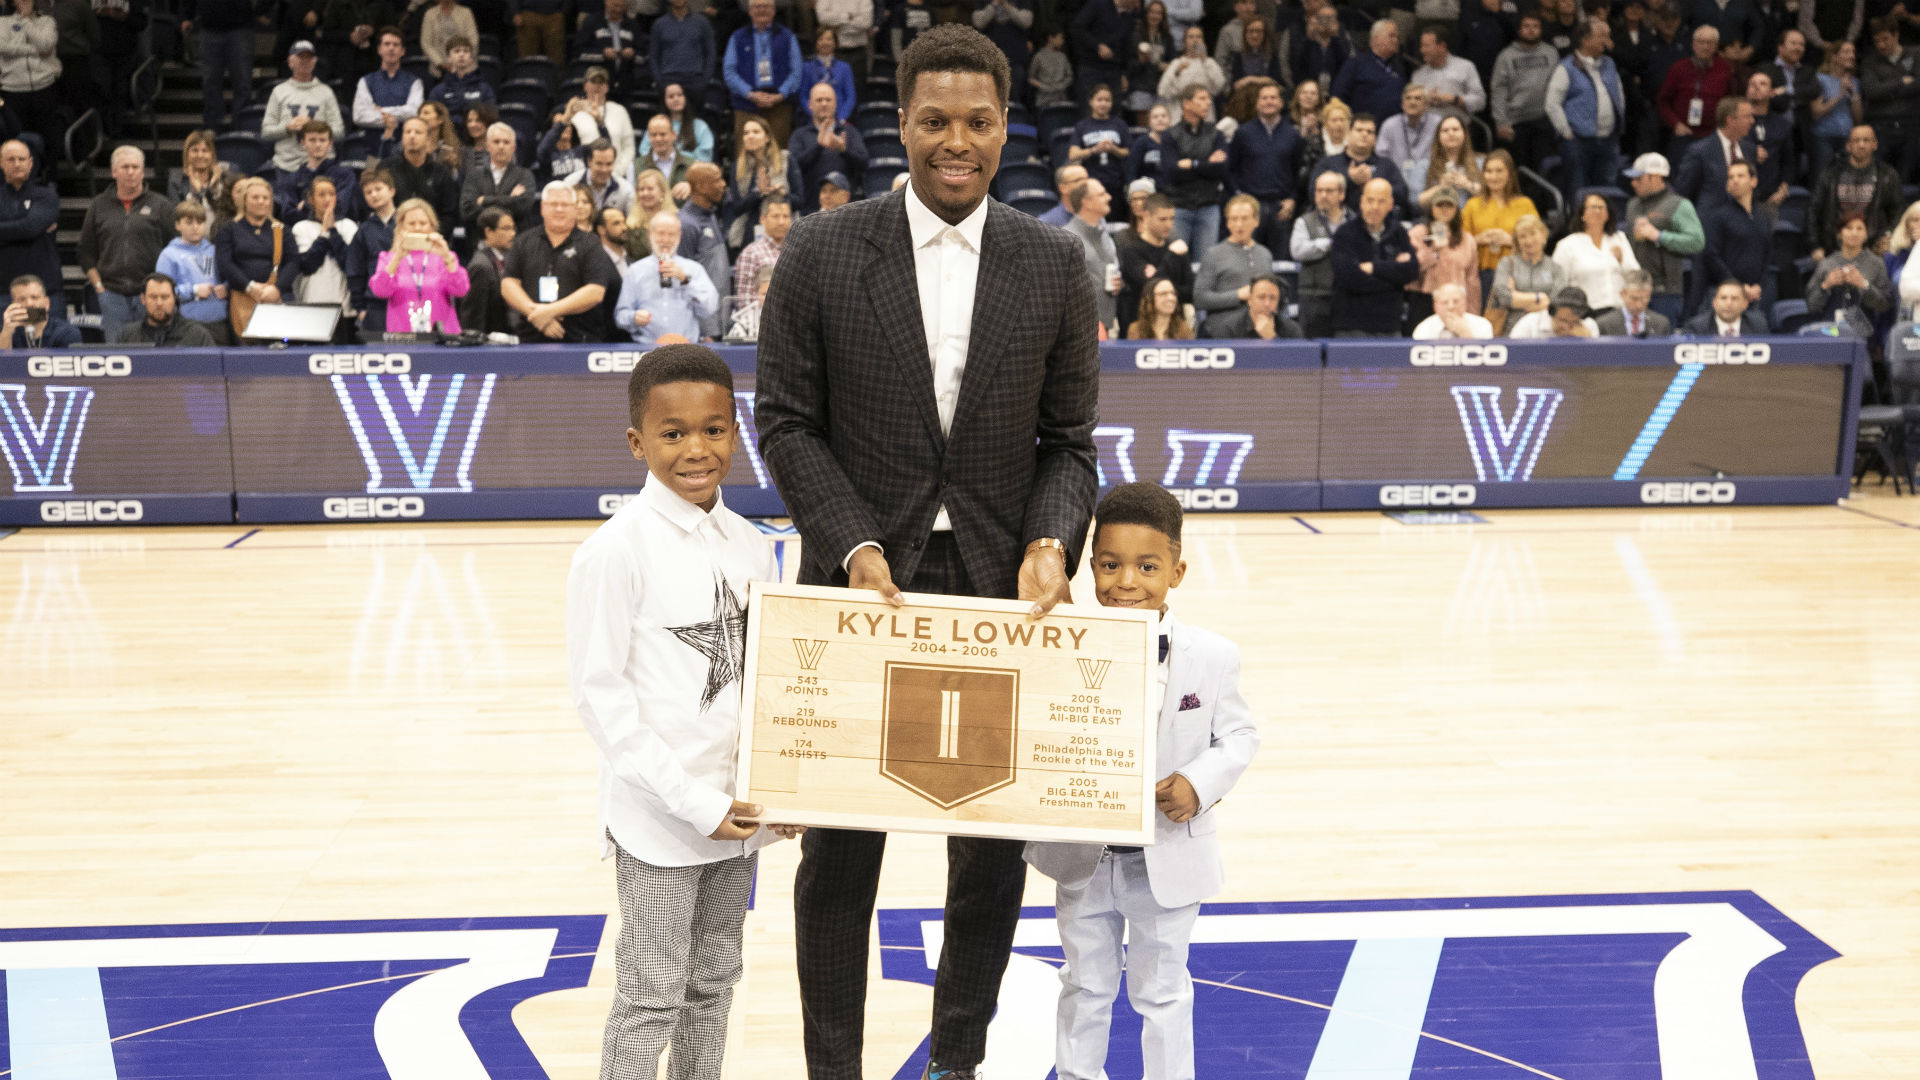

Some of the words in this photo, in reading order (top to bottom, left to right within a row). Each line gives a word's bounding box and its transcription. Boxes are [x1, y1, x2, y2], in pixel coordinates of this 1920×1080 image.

[1135, 347, 1235, 369] GEICO
[1410, 345, 1508, 367] GEICO
[1674, 343, 1771, 365] GEICO
[27, 355, 132, 378] GEICO
[309, 353, 411, 375] GEICO
[588, 351, 645, 373] GEI
[1379, 484, 1477, 506] GEICO
[1641, 481, 1736, 504] GEICO
[40, 500, 144, 522] GEICO
[323, 497, 424, 519] GEICO
[837, 611, 933, 640] KYLE
[952, 619, 1088, 650] LOWRY
[910, 641, 947, 654] 2004
[962, 645, 998, 657] 2006
[797, 676, 818, 685] 543
[785, 685, 828, 696] POINTS
[1071, 694, 1100, 704] 2006
[796, 707, 815, 717] 219
[1049, 703, 1089, 713] Second
[1093, 706, 1122, 715] Team
[773, 716, 837, 728] REBOUNDS
[1049, 713, 1088, 723] All-BIG
[1092, 716, 1121, 725] EAST
[794, 739, 812, 748] 174
[1070, 736, 1099, 745] 2005
[779, 749, 827, 759] ASSISTS
[1034, 743, 1102, 756] Philadelphia
[1106, 748, 1124, 758] Big
[1128, 750, 1134, 758] 5
[1033, 754, 1071, 764] Rookie
[1075, 757, 1086, 765] of
[1090, 758, 1107, 766] the
[1112, 759, 1135, 768] Year
[1069, 778, 1098, 787] 2005
[1047, 787, 1067, 796] BIG
[1071, 788, 1099, 798] EAST
[1103, 791, 1119, 800] All
[1039, 797, 1093, 808] Freshman
[1097, 800, 1126, 810] Team
